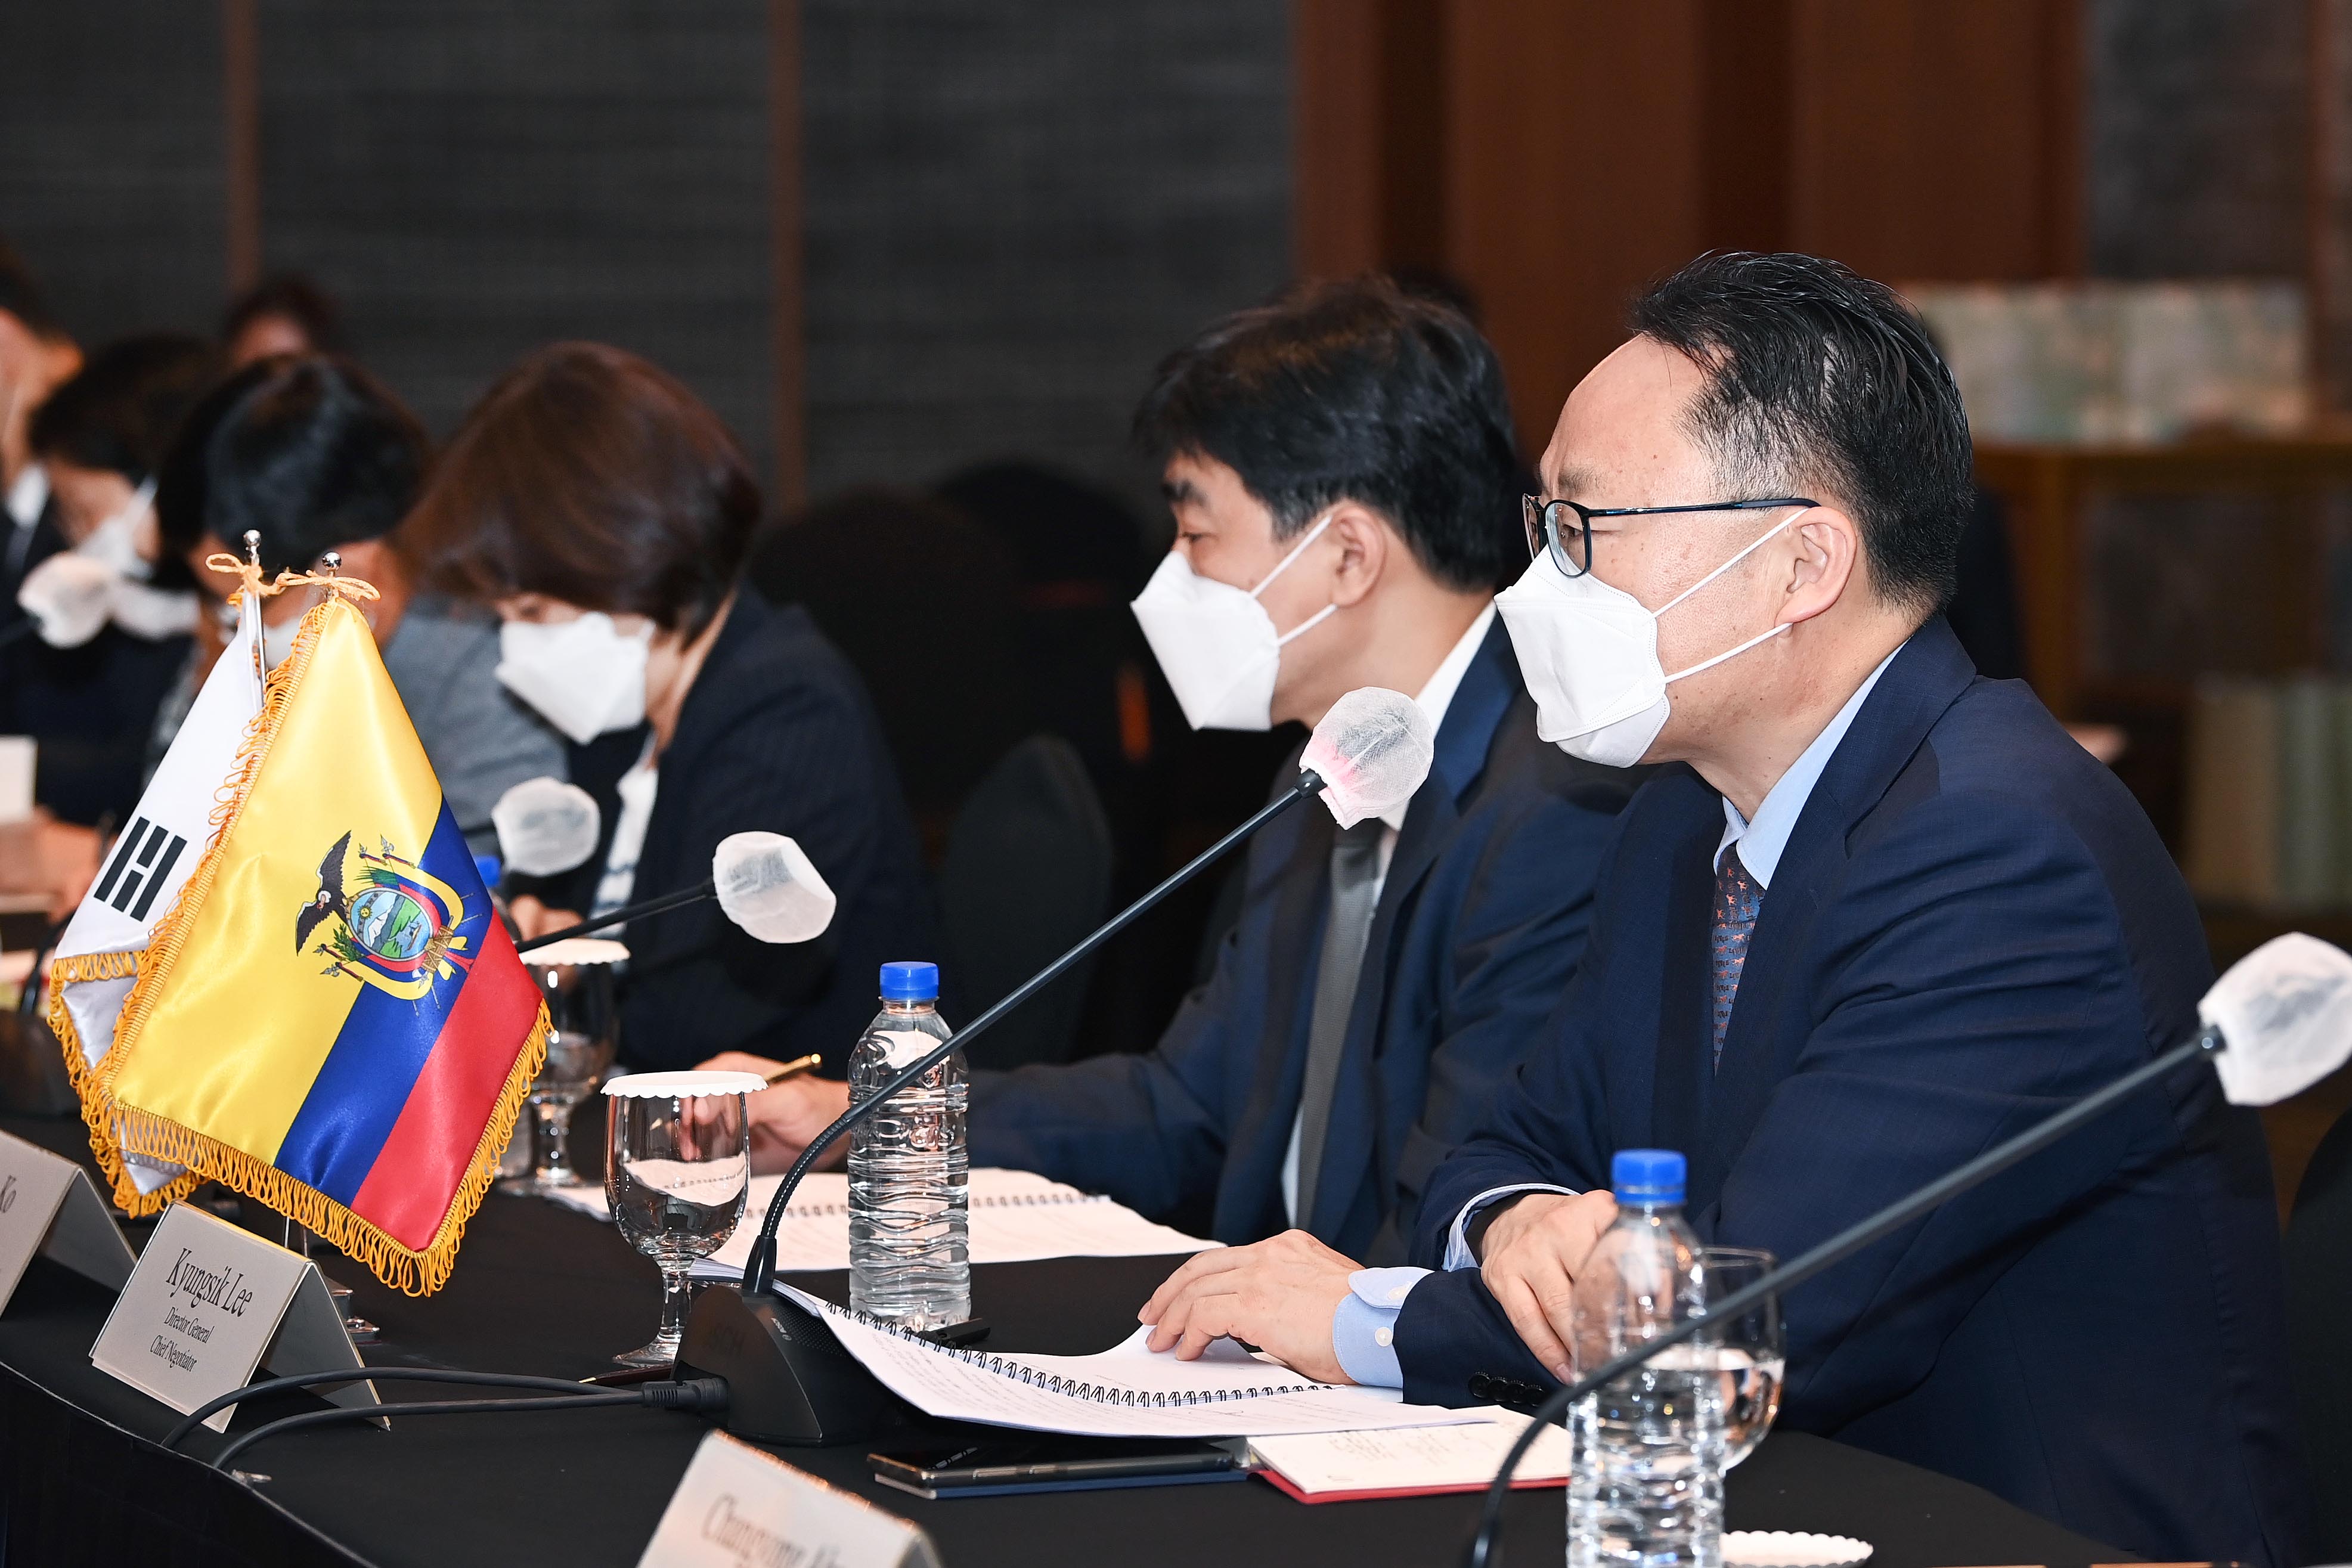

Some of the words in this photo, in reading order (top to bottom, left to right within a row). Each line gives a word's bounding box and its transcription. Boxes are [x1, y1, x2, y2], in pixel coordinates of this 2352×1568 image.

[166, 1248, 232, 1308] Kyungsik
[221, 1273, 253, 1317] Lee
[164, 1307, 190, 1333] Director
[187, 1318, 215, 1344] General
[150, 1334, 172, 1360] Chief
[165, 1341, 197, 1372] Negotiator
